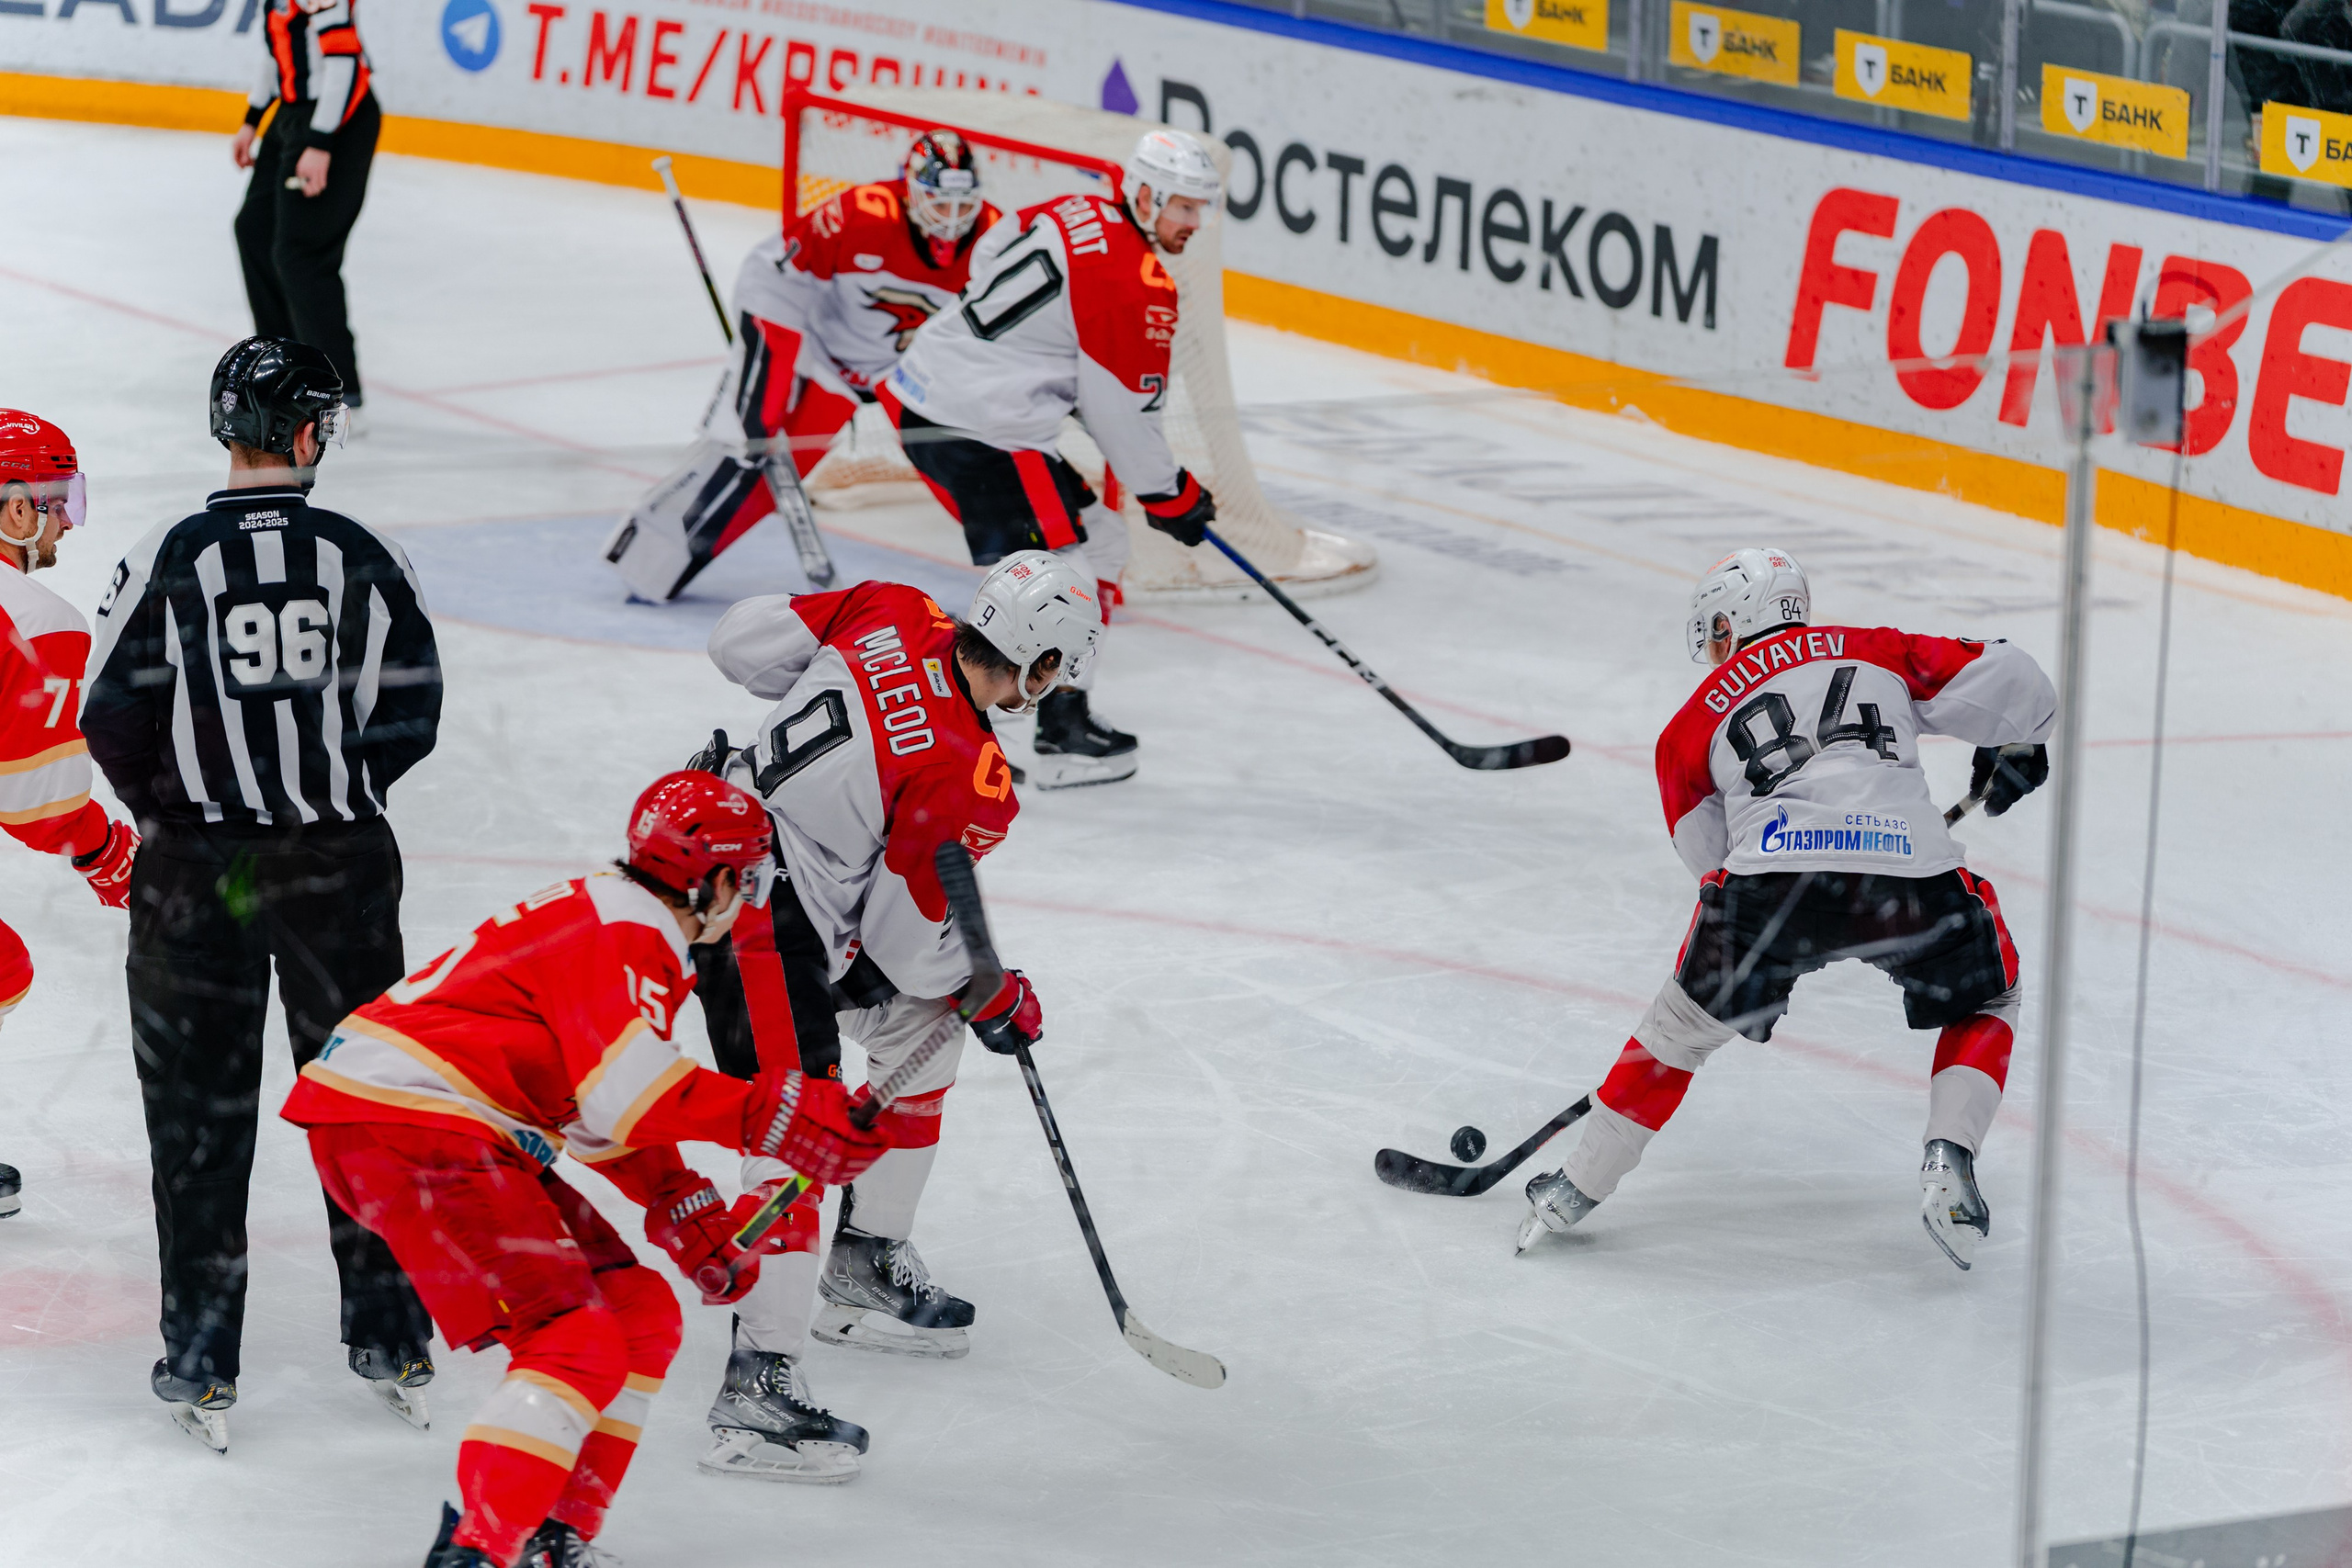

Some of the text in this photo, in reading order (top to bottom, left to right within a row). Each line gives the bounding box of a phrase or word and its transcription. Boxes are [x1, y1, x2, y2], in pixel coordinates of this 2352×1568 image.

[527, 3, 1039, 115] T.ME/KRS
[1724, 32, 1778, 62] БАНК
[1890, 64, 1947, 94] БАНК
[2101, 100, 2164, 132] БАНК
[958, 224, 1063, 342] 0
[238, 517, 289, 530] 2024-2025
[244, 510, 280, 521] SEASON
[977, 604, 996, 627] 9
[1780, 598, 1802, 621] 84
[224, 598, 329, 686] 96
[1703, 632, 1846, 715] GULYAYEV
[853, 625, 936, 758] MCLEOD
[741, 689, 854, 800] 9
[1725, 665, 1900, 797] 84
[1845, 814, 1881, 827] СЕТЬ
[710, 842, 743, 852] CCM
[1786, 829, 1912, 855] ГАЗПРОМНЕФТЬ
[623, 964, 671, 1032] 15
